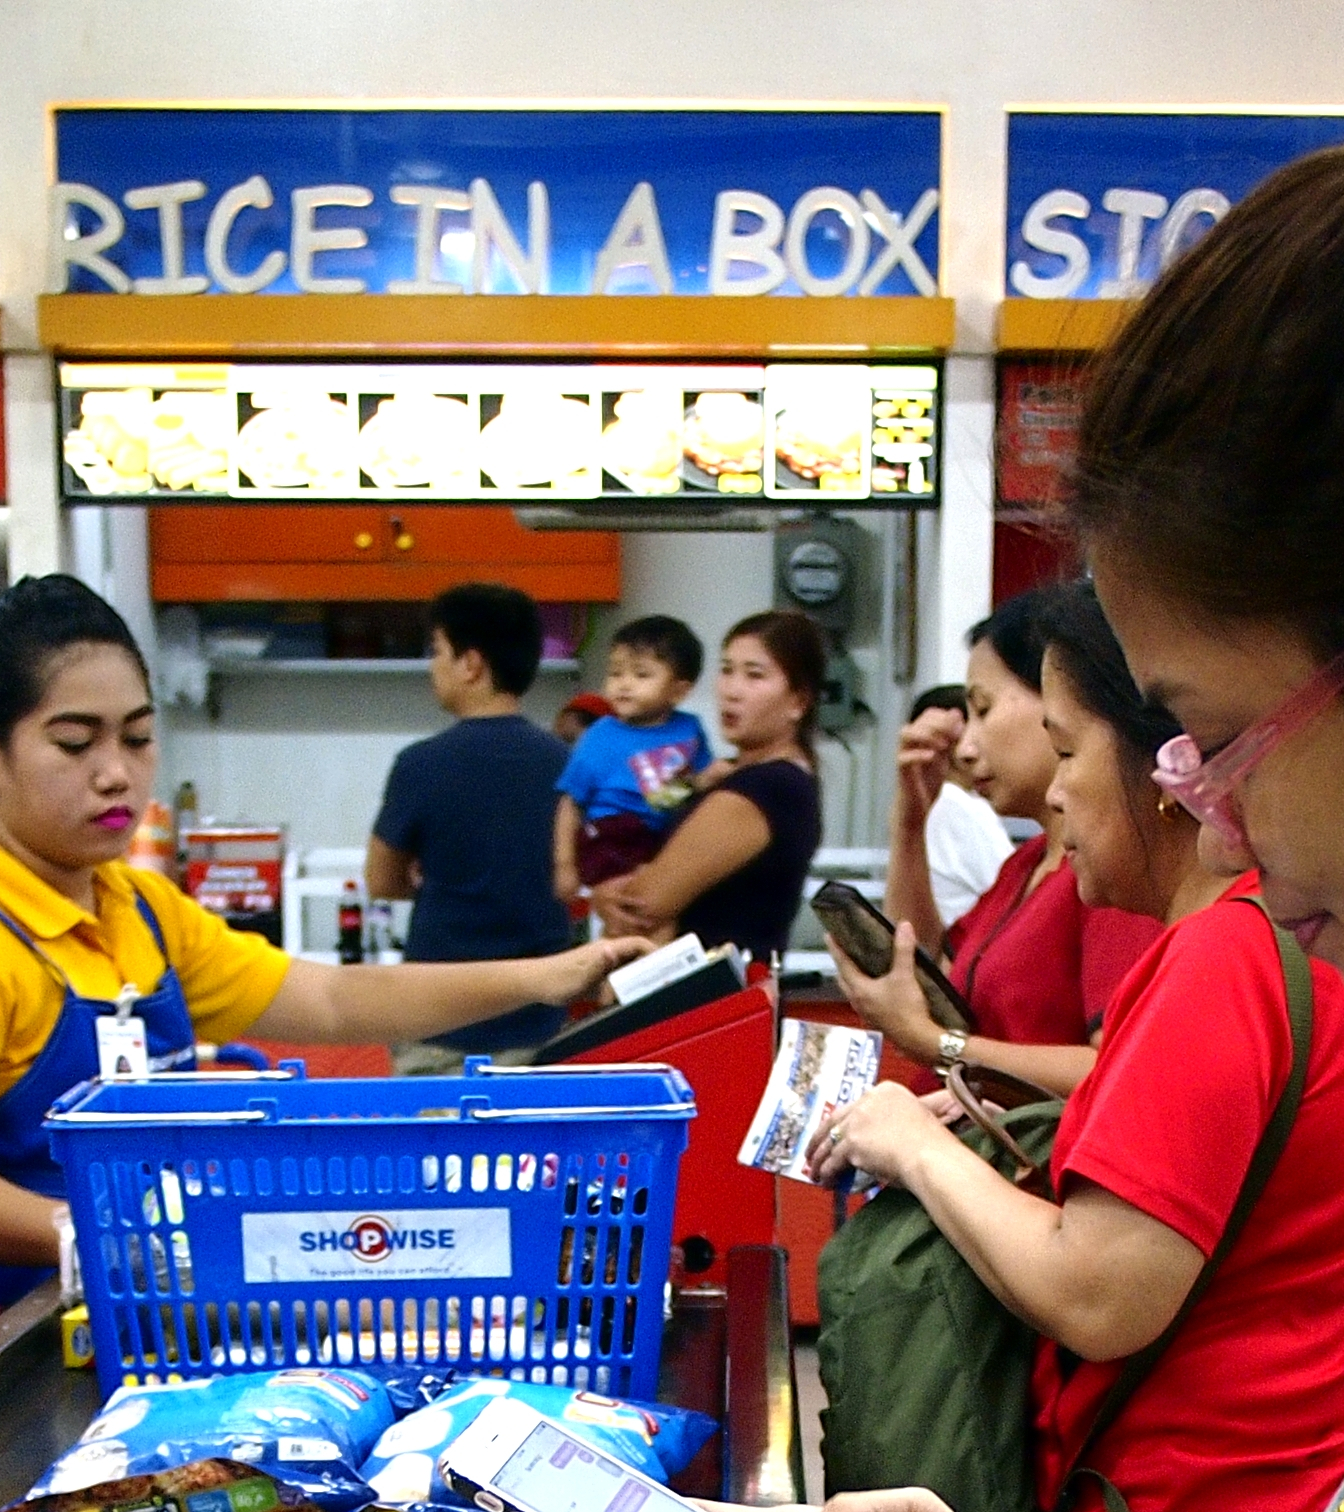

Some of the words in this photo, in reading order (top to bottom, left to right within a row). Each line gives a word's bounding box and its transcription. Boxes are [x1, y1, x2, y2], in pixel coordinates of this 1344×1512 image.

[54, 175, 374, 296] RICE
[390, 178, 548, 296] IN
[592, 181, 672, 296] A
[710, 186, 941, 297] BOX
[299, 1227, 456, 1253] SHOPWISE
